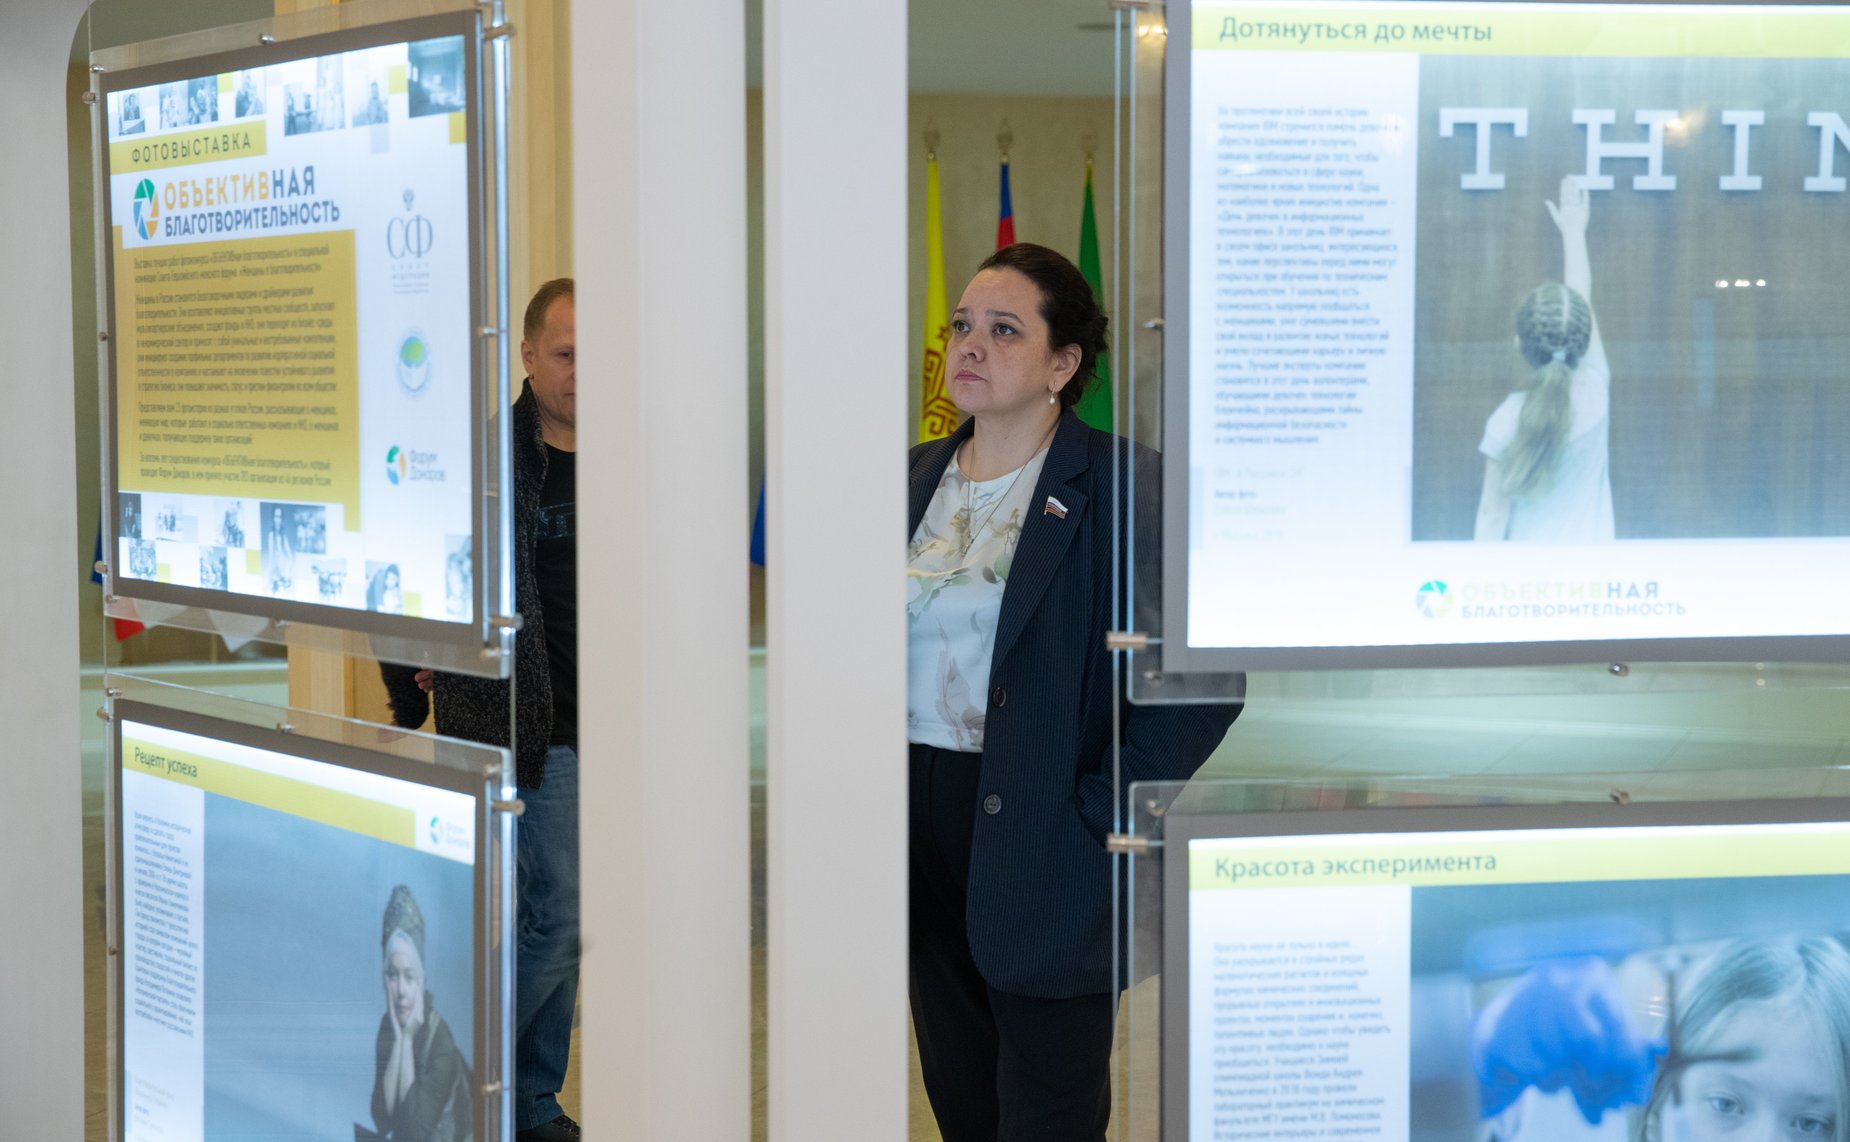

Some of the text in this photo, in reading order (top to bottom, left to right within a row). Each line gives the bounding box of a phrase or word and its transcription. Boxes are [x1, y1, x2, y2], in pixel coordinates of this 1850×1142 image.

[1220, 17, 1493, 44] Дотянуться до мечты
[131, 132, 252, 164] ФОТОВЫСТАВКА
[164, 165, 316, 210] ОБЪЕКТИВНАЯ
[165, 199, 340, 238] БЛАГОТВОРИТЕЛЬНОСТЬ
[387, 214, 433, 259] СФ
[1462, 581, 1661, 602] ОБЪЕКТИВНАЯ
[1462, 601, 1687, 620] БЛАГОТВОРИТЕЛЬНОСТЬ
[134, 746, 198, 779] Рецепт успеха
[1215, 854, 1496, 882] Красота эксперимента
